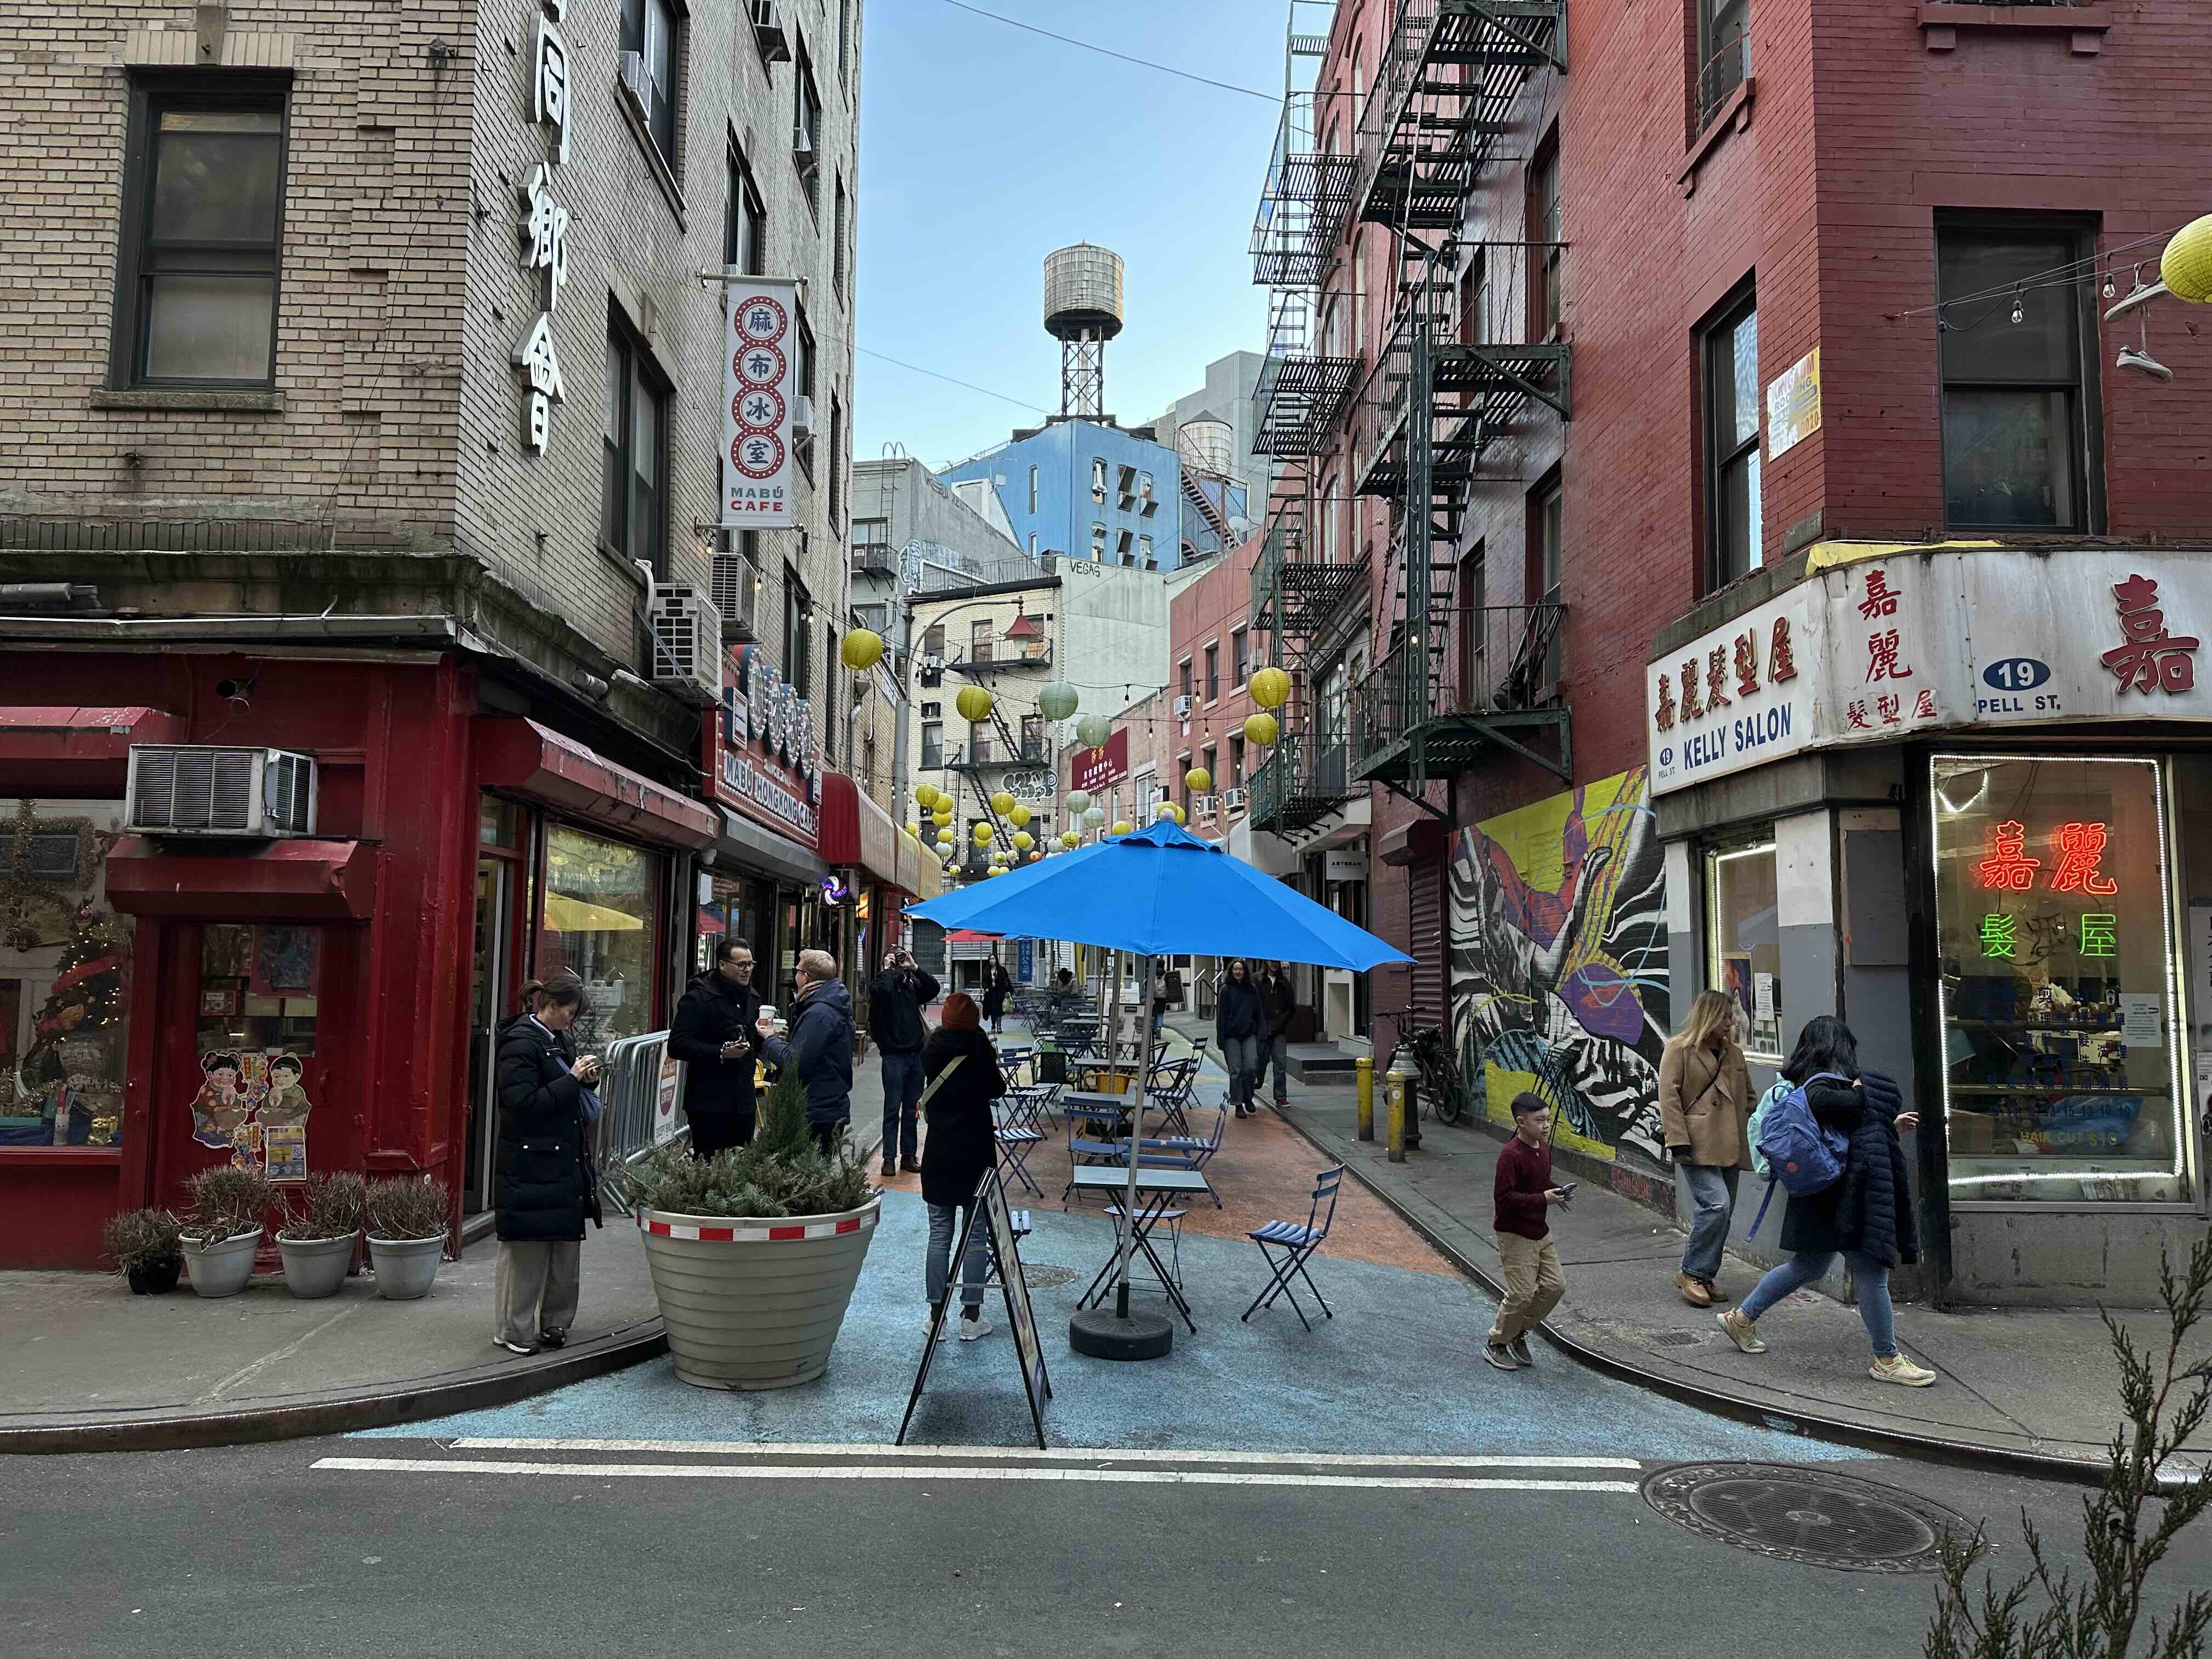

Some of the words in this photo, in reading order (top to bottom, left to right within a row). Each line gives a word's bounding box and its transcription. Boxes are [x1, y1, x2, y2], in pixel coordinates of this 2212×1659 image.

[522, 0, 571, 458] 同鄉會
[746, 308, 773, 464] 麻布冰室
[730, 500, 783, 512] CAFE
[1070, 560, 1101, 578] VEGAS
[1858, 569, 1912, 684] 嘉麗
[2100, 574, 2200, 695] 嘉
[1655, 616, 1798, 733] 嘉麗髮型屋
[1997, 662, 2035, 687] 19
[1847, 689, 1937, 732] 髮型屋
[1978, 698, 2024, 713] PELL
[2035, 695, 2061, 711] ST.
[1662, 749, 1671, 764] 19
[1684, 725, 1727, 770] KELLY
[1735, 702, 1791, 752] SALON
[1658, 770, 1668, 779] PELL
[755, 774, 798, 823] HONGKONG
[1979, 820, 2118, 895] 嘉麗
[2020, 1131, 2051, 1144] HAIR
